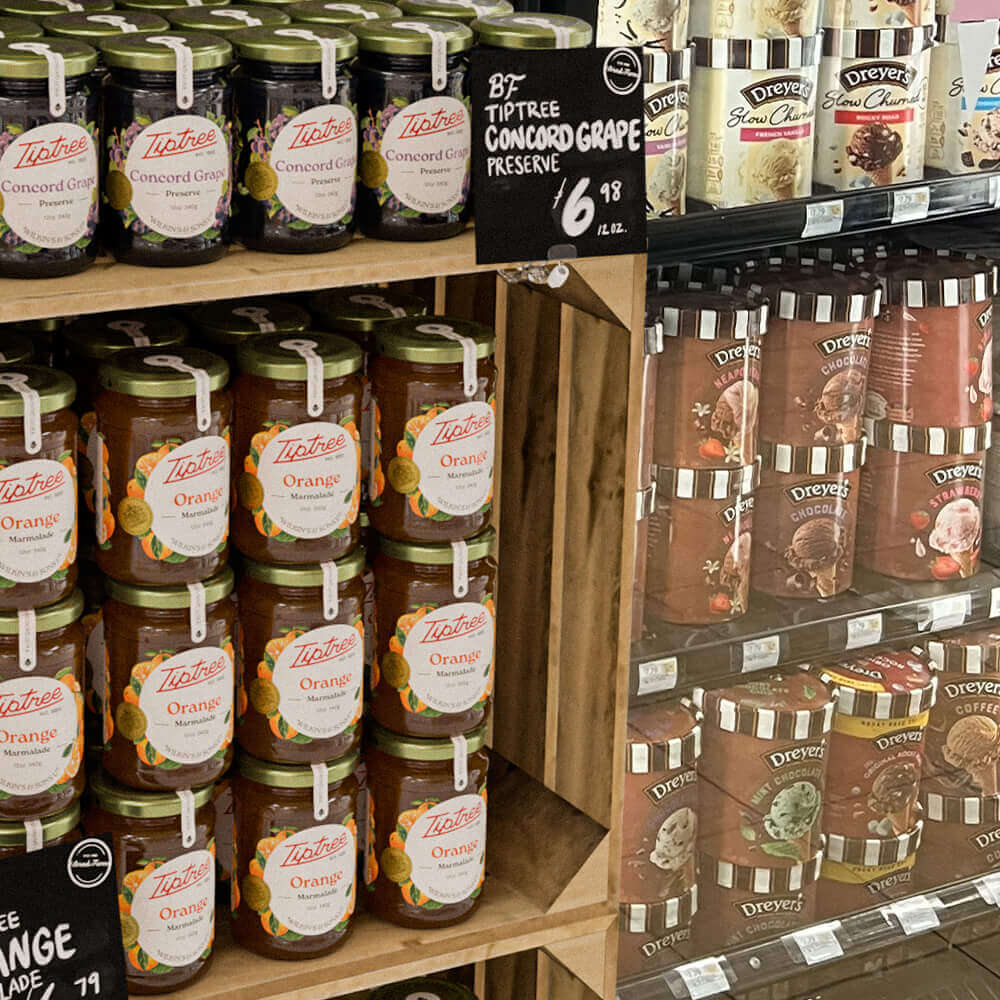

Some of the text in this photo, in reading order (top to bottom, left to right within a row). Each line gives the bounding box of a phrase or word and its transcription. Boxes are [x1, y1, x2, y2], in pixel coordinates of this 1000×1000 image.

[488, 72, 527, 100] BF
[845, 65, 913, 86] Dreyer's
[822, 89, 862, 110] Slow
[484, 100, 561, 123] TIPTREE
[727, 107, 768, 128] Slow
[288, 115, 353, 150] Tiptree
[397, 107, 465, 140] Tiptree
[484, 118, 641, 152] CONCORD GRAPE
[13, 133, 89, 170] Tiptree
[142, 125, 217, 160] Tiptree
[275, 159, 333, 174] Concord
[385, 148, 443, 162] Concord
[487, 153, 561, 177] PRESERVE
[1, 178, 65, 194] Concord
[129, 168, 225, 185] Concord Grape
[165, 189, 201, 200] Preserve
[600, 180, 623, 204] 98
[429, 411, 492, 446] Tiptree
[273, 433, 346, 464] Tiptree
[440, 450, 488, 468] Orange
[162, 445, 226, 485] Tiptree
[282, 472, 341, 488] Orange
[173, 488, 225, 508] Orange
[290, 490, 335, 501] Marmalade
[0, 512, 61, 532] Orange
[8, 531, 55, 544] Marmalade
[419, 610, 488, 644] Tiptree
[289, 633, 357, 669] Tiptree
[429, 649, 482, 667] Orange
[155, 655, 227, 693] Tiptree
[300, 673, 352, 691] Orange
[167, 694, 223, 716] Orange
[3, 745, 51, 758] Marmalade
[423, 803, 482, 840] Tiptree
[280, 831, 348, 868] Tiptree
[430, 836, 480, 860] Orange
[149, 856, 211, 900] Tiptree
[290, 870, 343, 890] Orange
[159, 896, 208, 921] Orange
